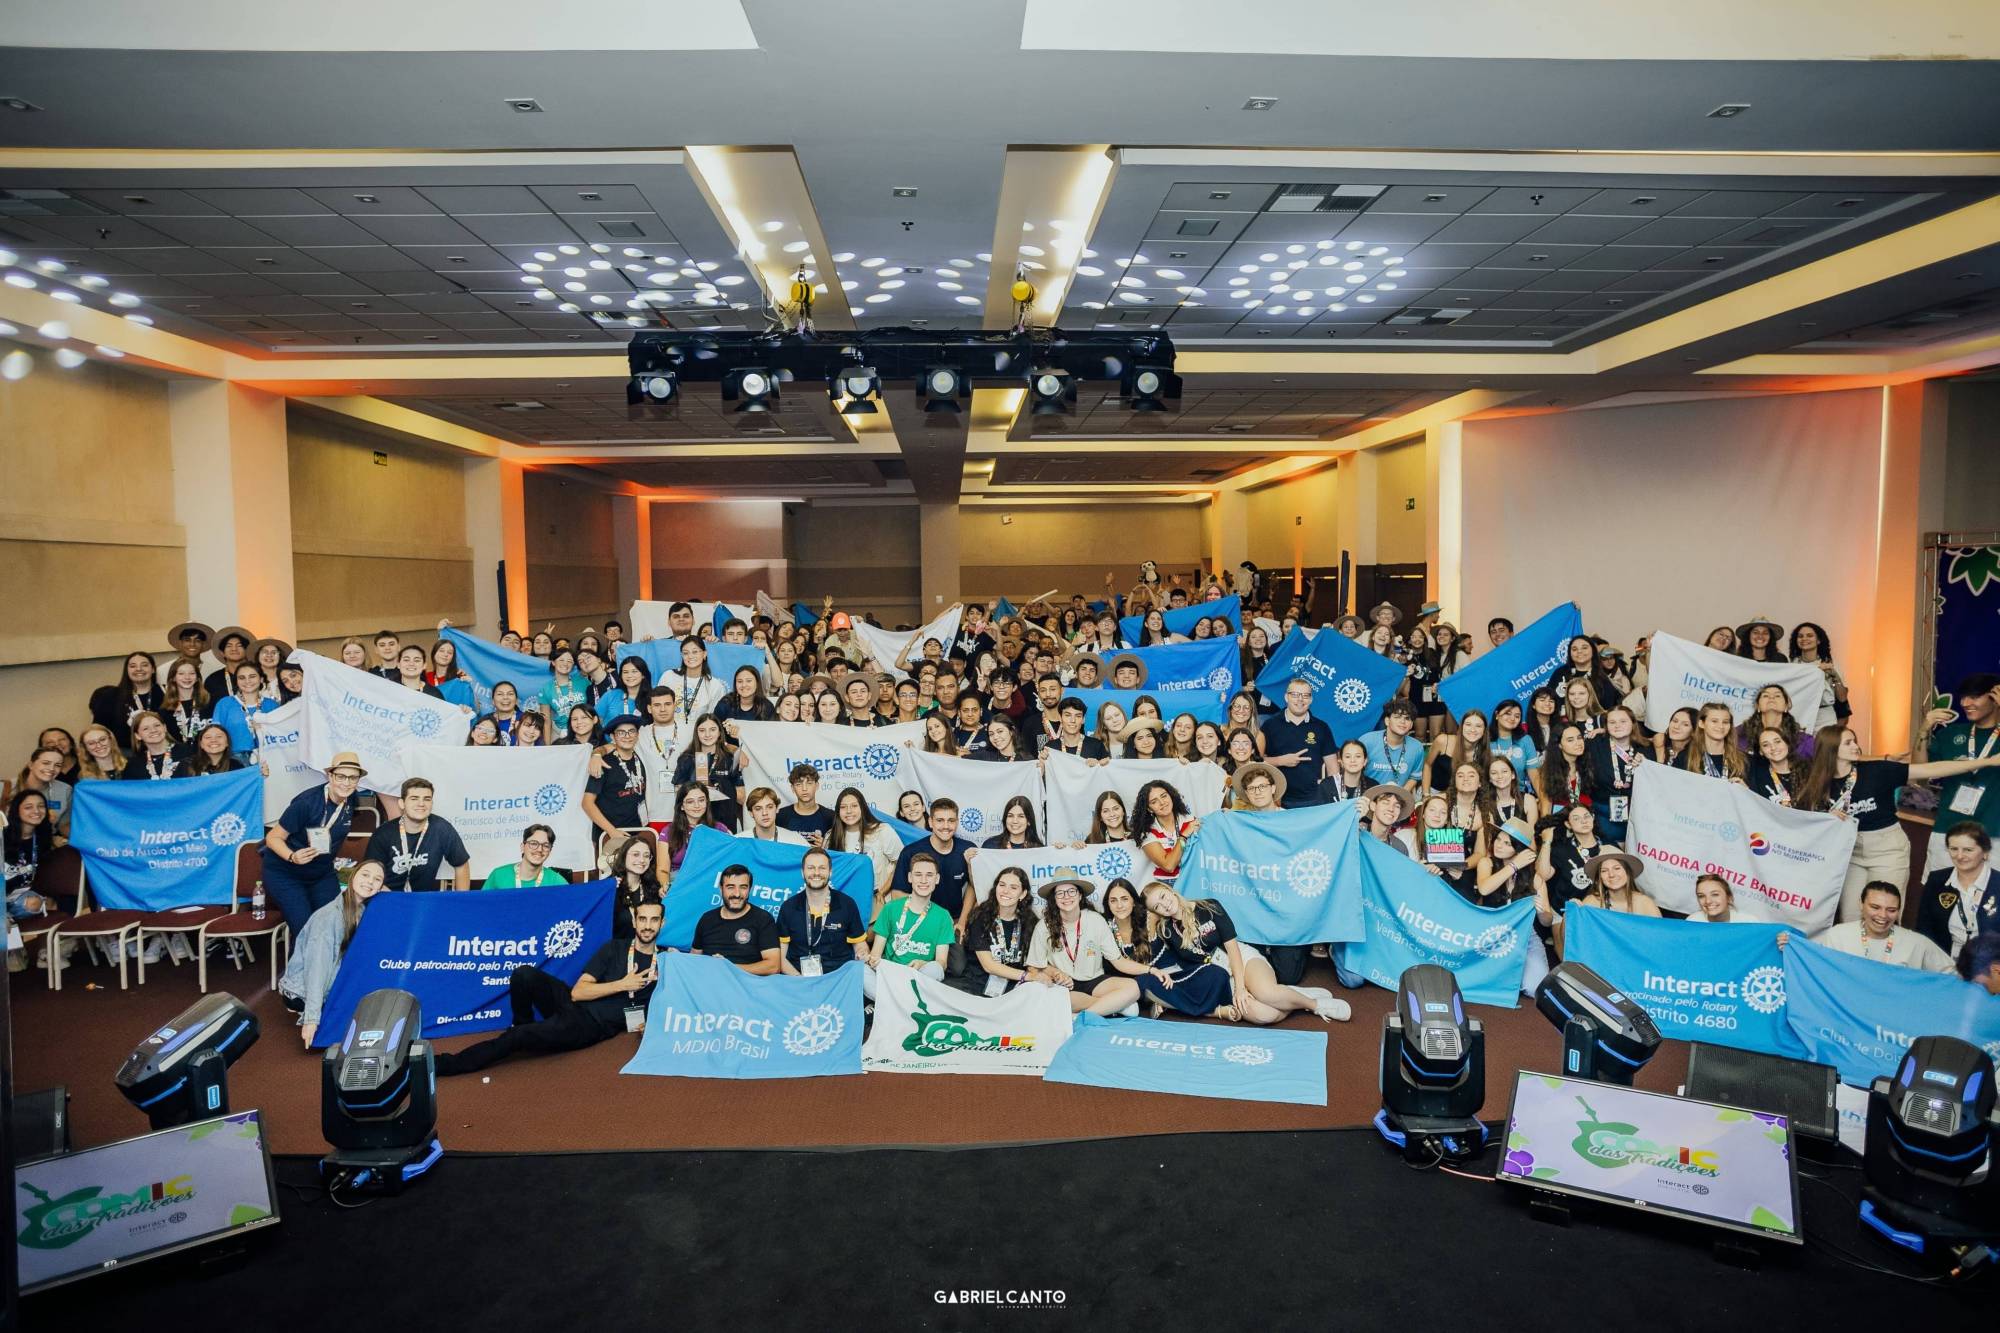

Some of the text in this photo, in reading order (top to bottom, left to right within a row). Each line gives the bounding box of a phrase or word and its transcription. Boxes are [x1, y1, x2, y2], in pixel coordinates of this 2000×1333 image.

[1157, 676, 1207, 692] Interact
[1511, 657, 1559, 690] Interact
[1683, 672, 1748, 699] Interact
[343, 691, 405, 724] Interact
[464, 797, 530, 811] Interact
[454, 815, 493, 826] Francisco
[496, 815, 508, 825] de
[140, 828, 208, 845] Interact
[1426, 828, 1464, 844] COMIC
[148, 859, 183, 870] Distrito
[1032, 864, 1094, 879] Intact
[1200, 849, 1281, 882] Interact
[1637, 842, 1812, 911] ISADORA ORTIZ BARDEN
[713, 871, 793, 902] Iract
[1201, 877, 1247, 896] Distrito
[1397, 901, 1474, 949] Interact
[448, 936, 538, 957] Interact
[379, 959, 411, 970] Clube
[414, 961, 476, 971] patrocinado
[478, 962, 501, 972] pelo
[1430, 954, 1463, 969] Aires
[1644, 970, 1738, 999] Interact
[1624, 990, 1738, 1014] trocinado pelo Rotary
[475, 1010, 502, 1020] 4.780
[663, 1006, 775, 1042] Interact
[1640, 1005, 1737, 1030] istrito 4680
[922, 1020, 1037, 1048] COMIC
[1109, 1034, 1217, 1055] Interact
[724, 1034, 770, 1060] Brasil
[1590, 1130, 1720, 1169] COMIC
